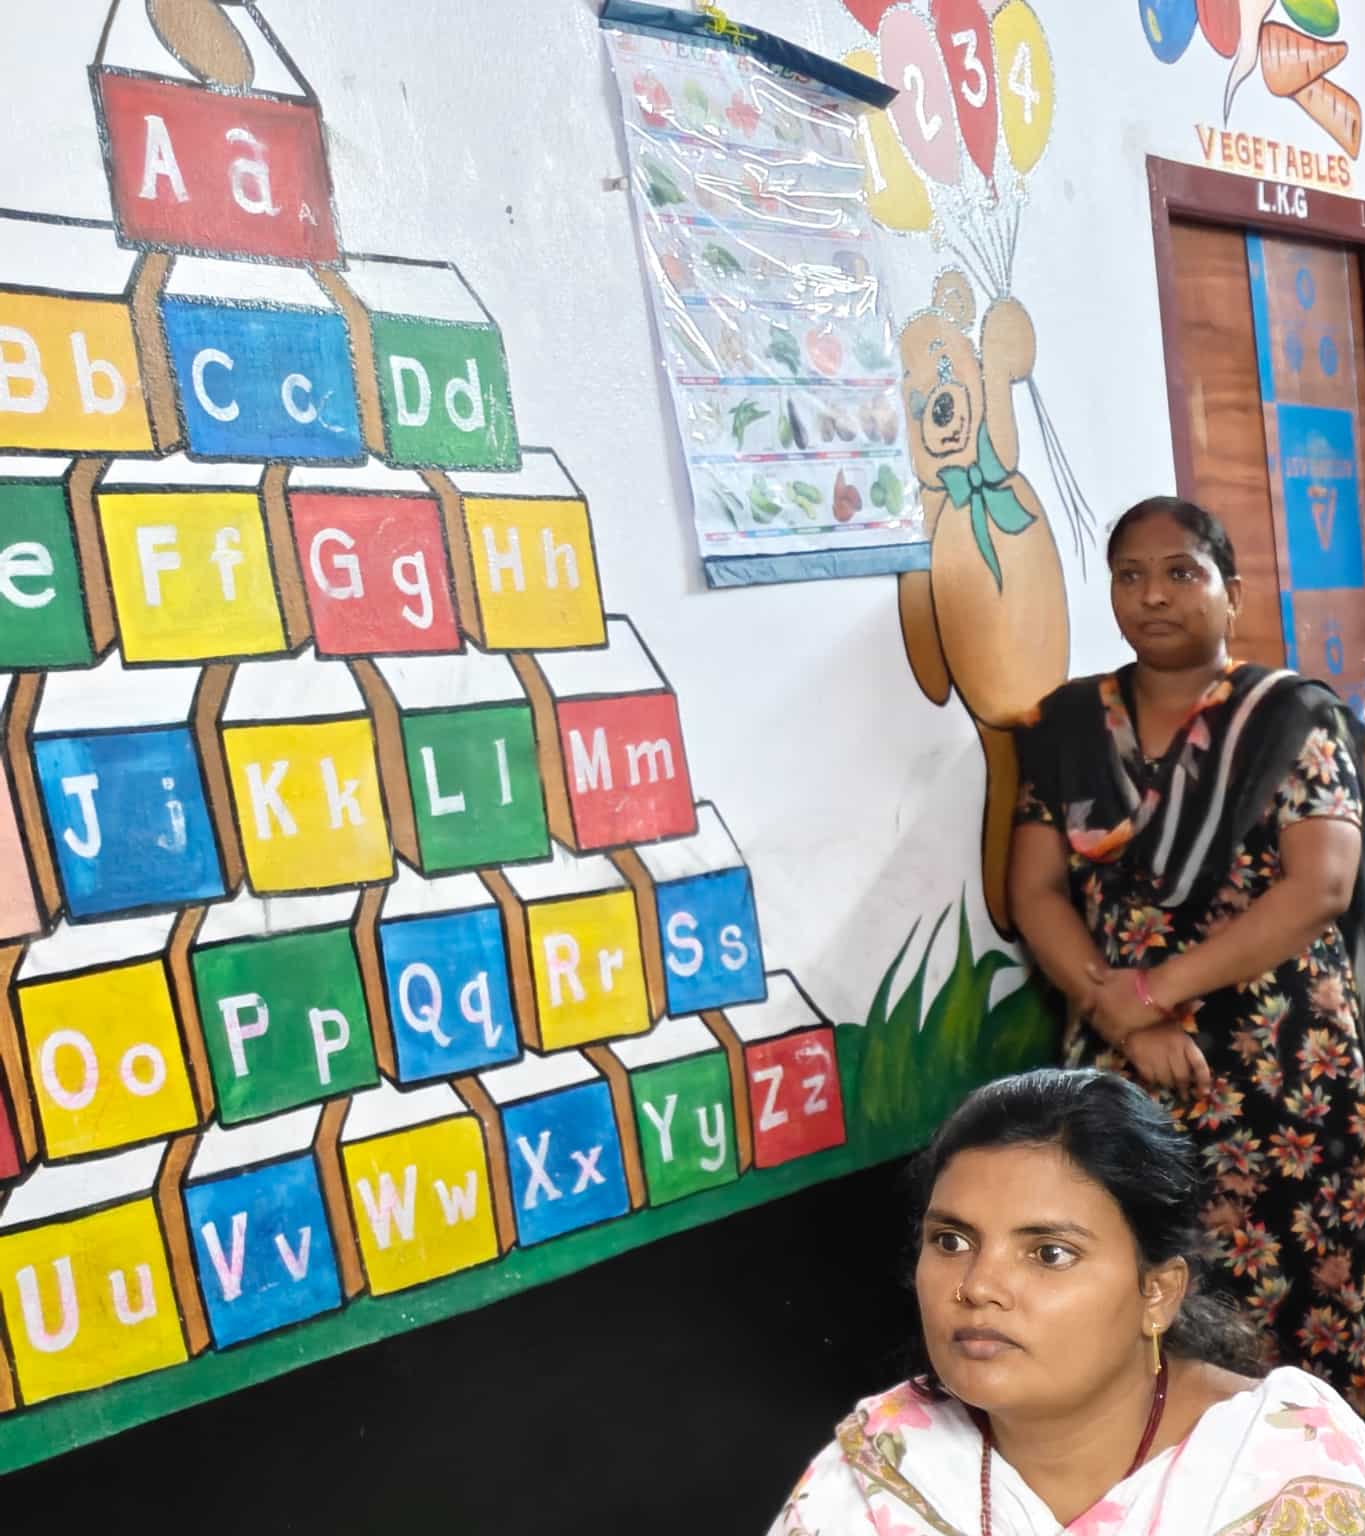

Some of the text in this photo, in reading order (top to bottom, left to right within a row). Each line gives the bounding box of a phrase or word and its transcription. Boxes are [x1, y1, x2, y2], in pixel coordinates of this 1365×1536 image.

[904, 63, 943, 141] 2
[951, 29, 987, 108] 3
[1008, 41, 1041, 125] 4
[1194, 123, 1355, 189] VEGETABLES
